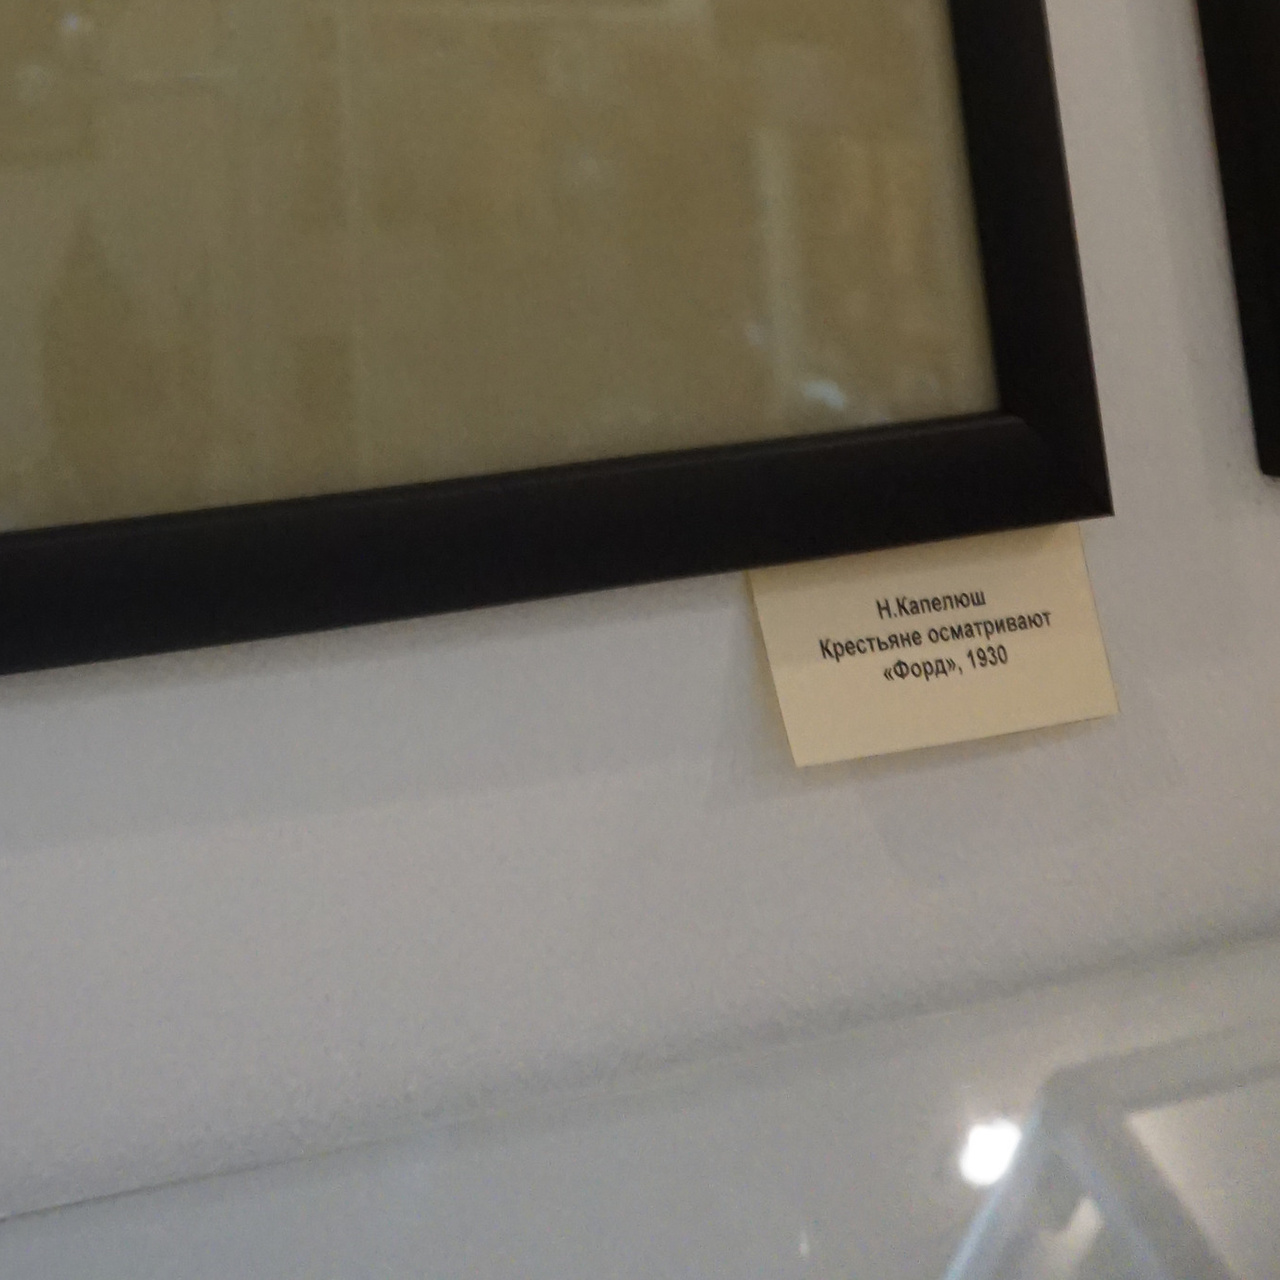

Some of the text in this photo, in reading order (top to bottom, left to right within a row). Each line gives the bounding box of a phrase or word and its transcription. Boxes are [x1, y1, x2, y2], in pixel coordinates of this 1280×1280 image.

[875, 589, 987, 620] Н.Капелюш
[819, 610, 1052, 662] Крестьяне осматривают
[883, 644, 1009, 682] «Форд», 1930
